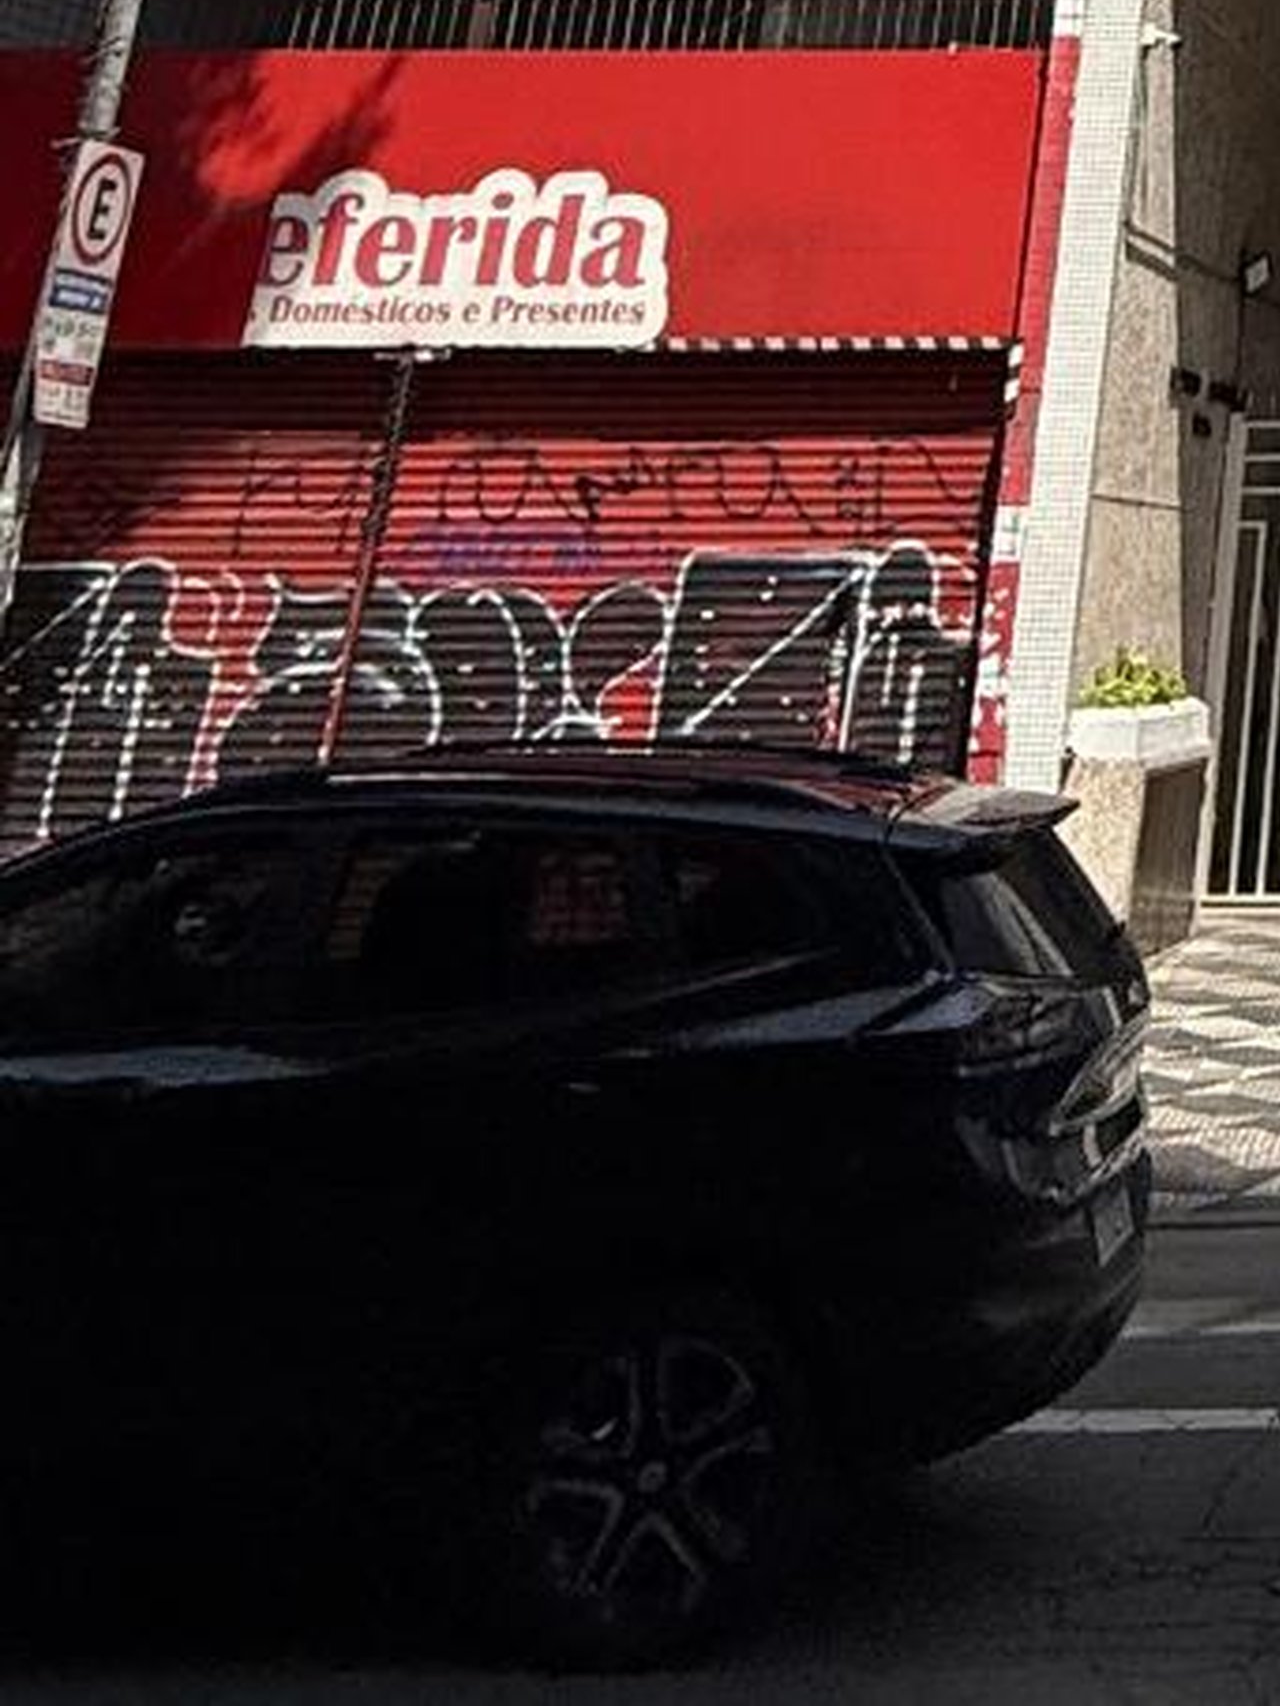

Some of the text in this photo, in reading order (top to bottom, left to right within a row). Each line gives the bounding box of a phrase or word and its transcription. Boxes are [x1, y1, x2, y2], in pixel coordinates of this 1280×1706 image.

[87, 178, 118, 240] E
[260, 193, 645, 289] eferida
[463, 302, 482, 324] e
[491, 296, 646, 325] Presentes
